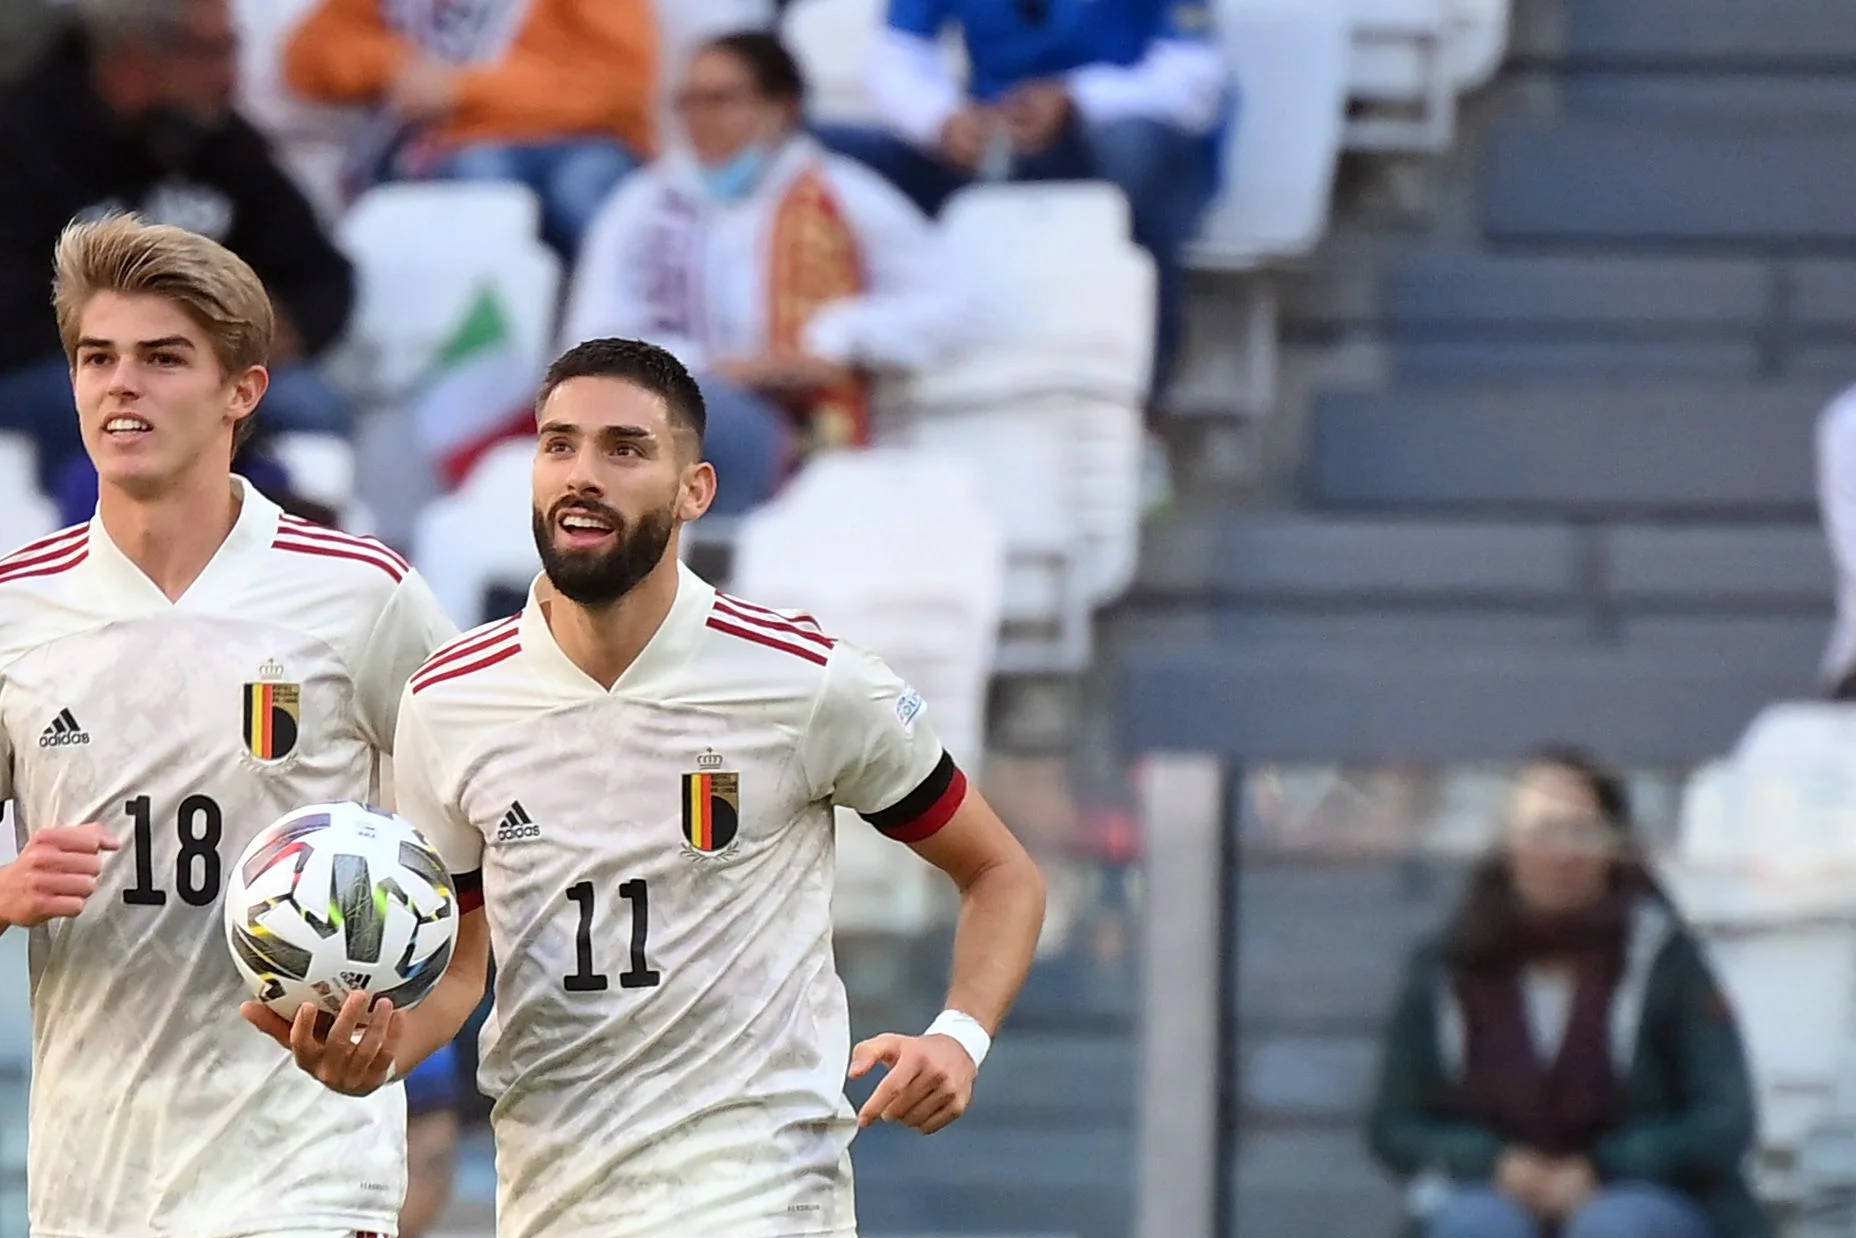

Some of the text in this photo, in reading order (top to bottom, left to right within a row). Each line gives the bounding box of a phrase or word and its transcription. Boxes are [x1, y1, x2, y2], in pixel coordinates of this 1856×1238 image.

[39, 731, 90, 747] adidas
[122, 794, 222, 906] 18
[563, 878, 660, 991] 11
